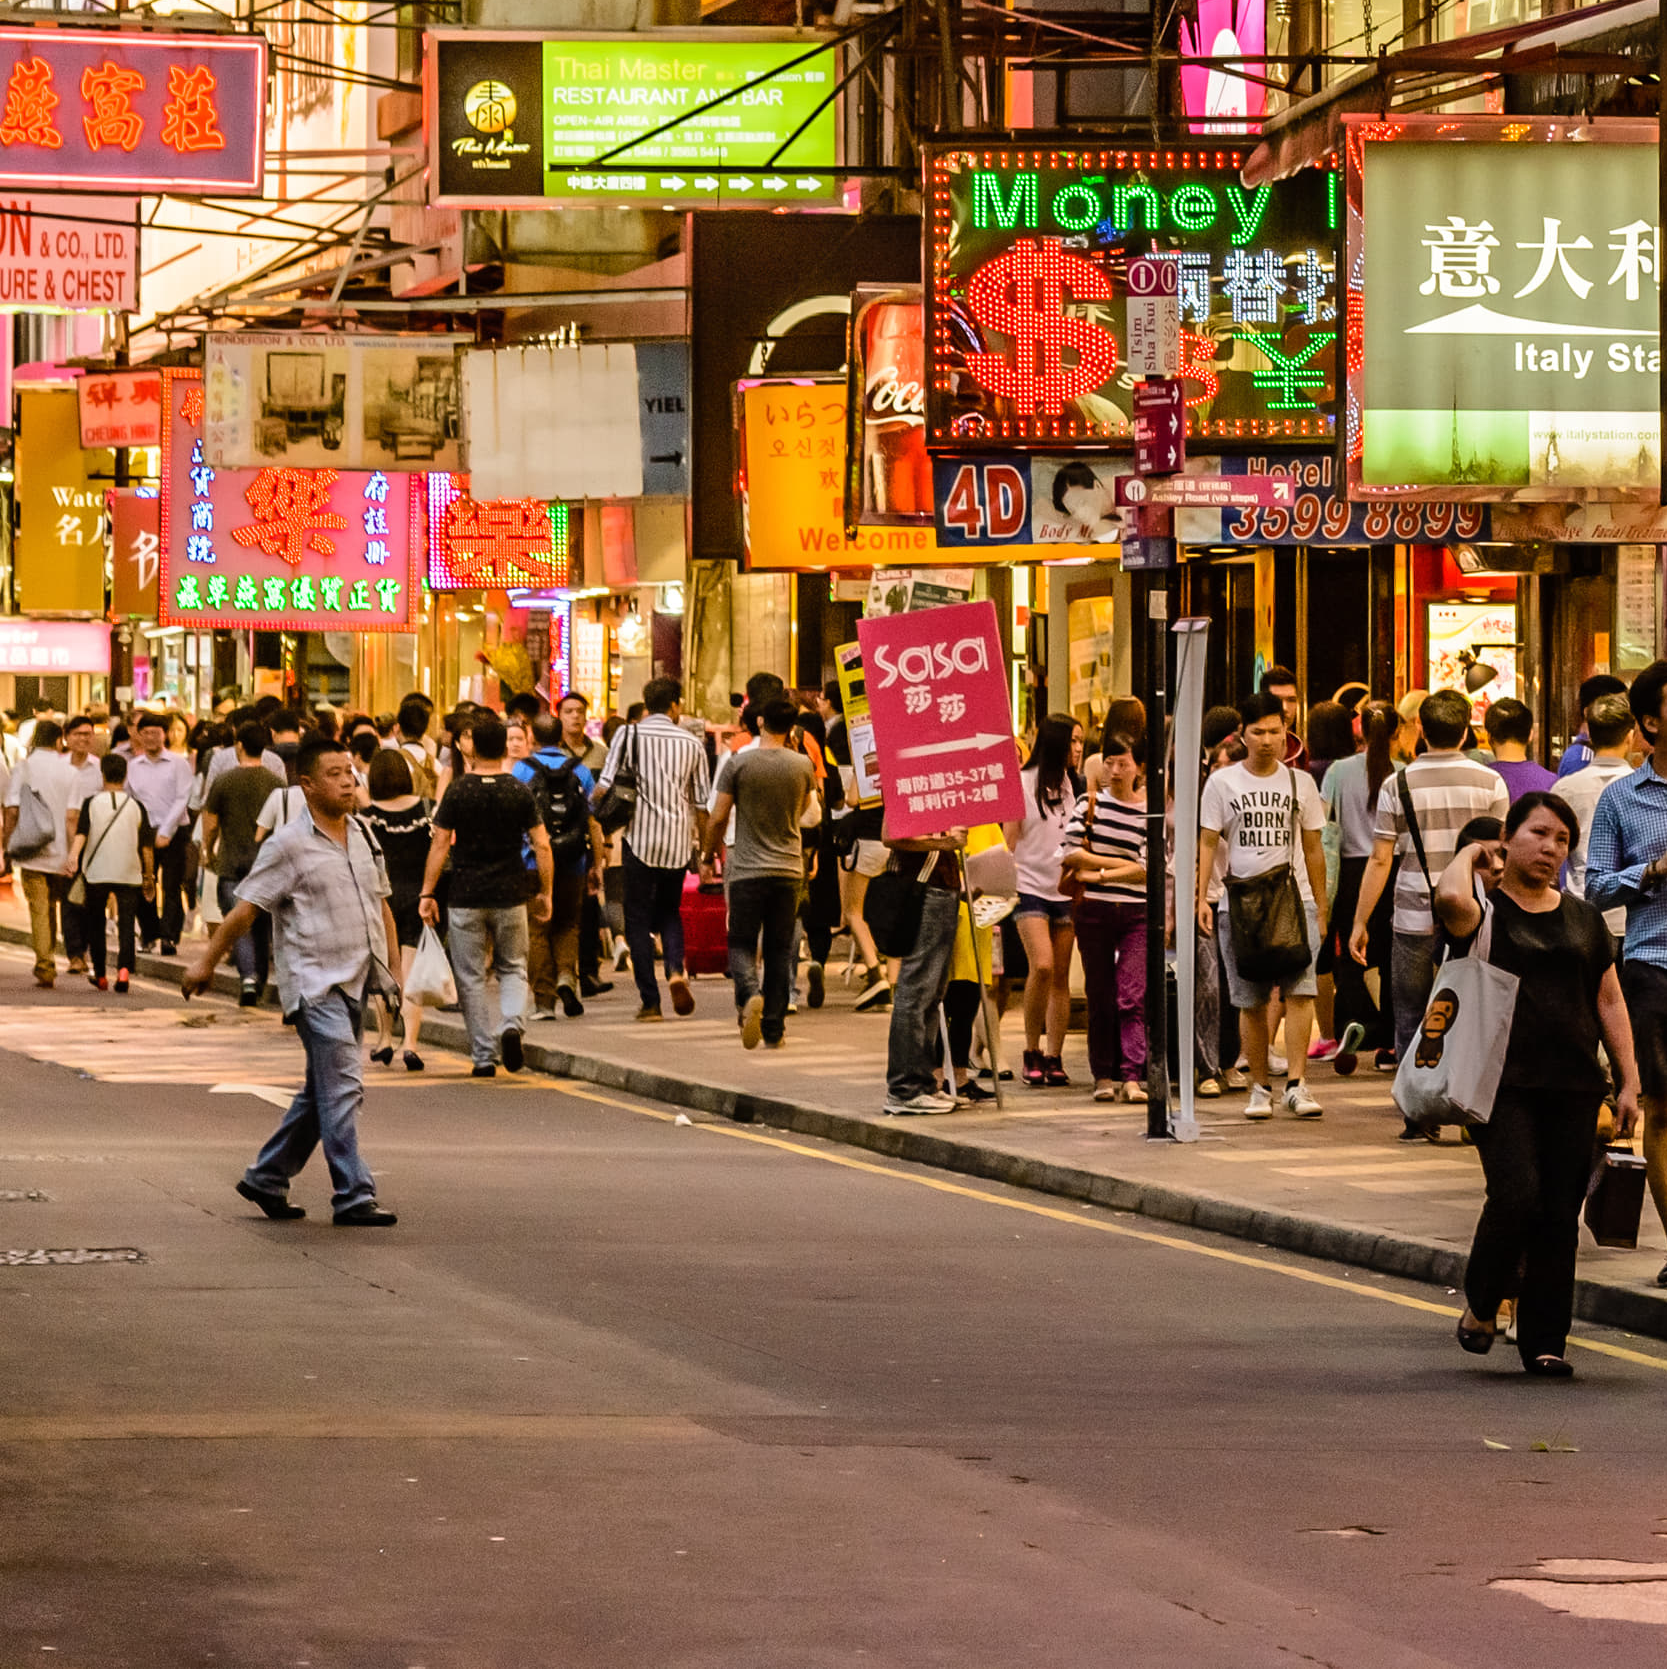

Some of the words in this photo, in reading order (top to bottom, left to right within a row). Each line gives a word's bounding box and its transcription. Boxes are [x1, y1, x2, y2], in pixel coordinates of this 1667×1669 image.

[555, 58, 610, 80] Thai
[620, 58, 707, 80] Master
[554, 87, 689, 105] RESTAURANT
[742, 90, 783, 105] BAR
[616, 116, 649, 126] AREA
[972, 172, 1271, 245] Money
[40, 235, 51, 257] &
[44, 271, 56, 300] &
[63, 271, 126, 302] CHEST
[1145, 302, 1156, 337] Tsui
[1131, 317, 1142, 357] Tsim
[1145, 342, 1157, 371] Sha
[1515, 342, 1593, 379] Italy
[943, 464, 1028, 539] 4D
[1186, 493, 1210, 502] Road
[1229, 492, 1351, 539] 3599
[1365, 502, 1484, 539] 8899
[904, 685, 966, 723] 莎莎
[1245, 812, 1286, 830] BORN
